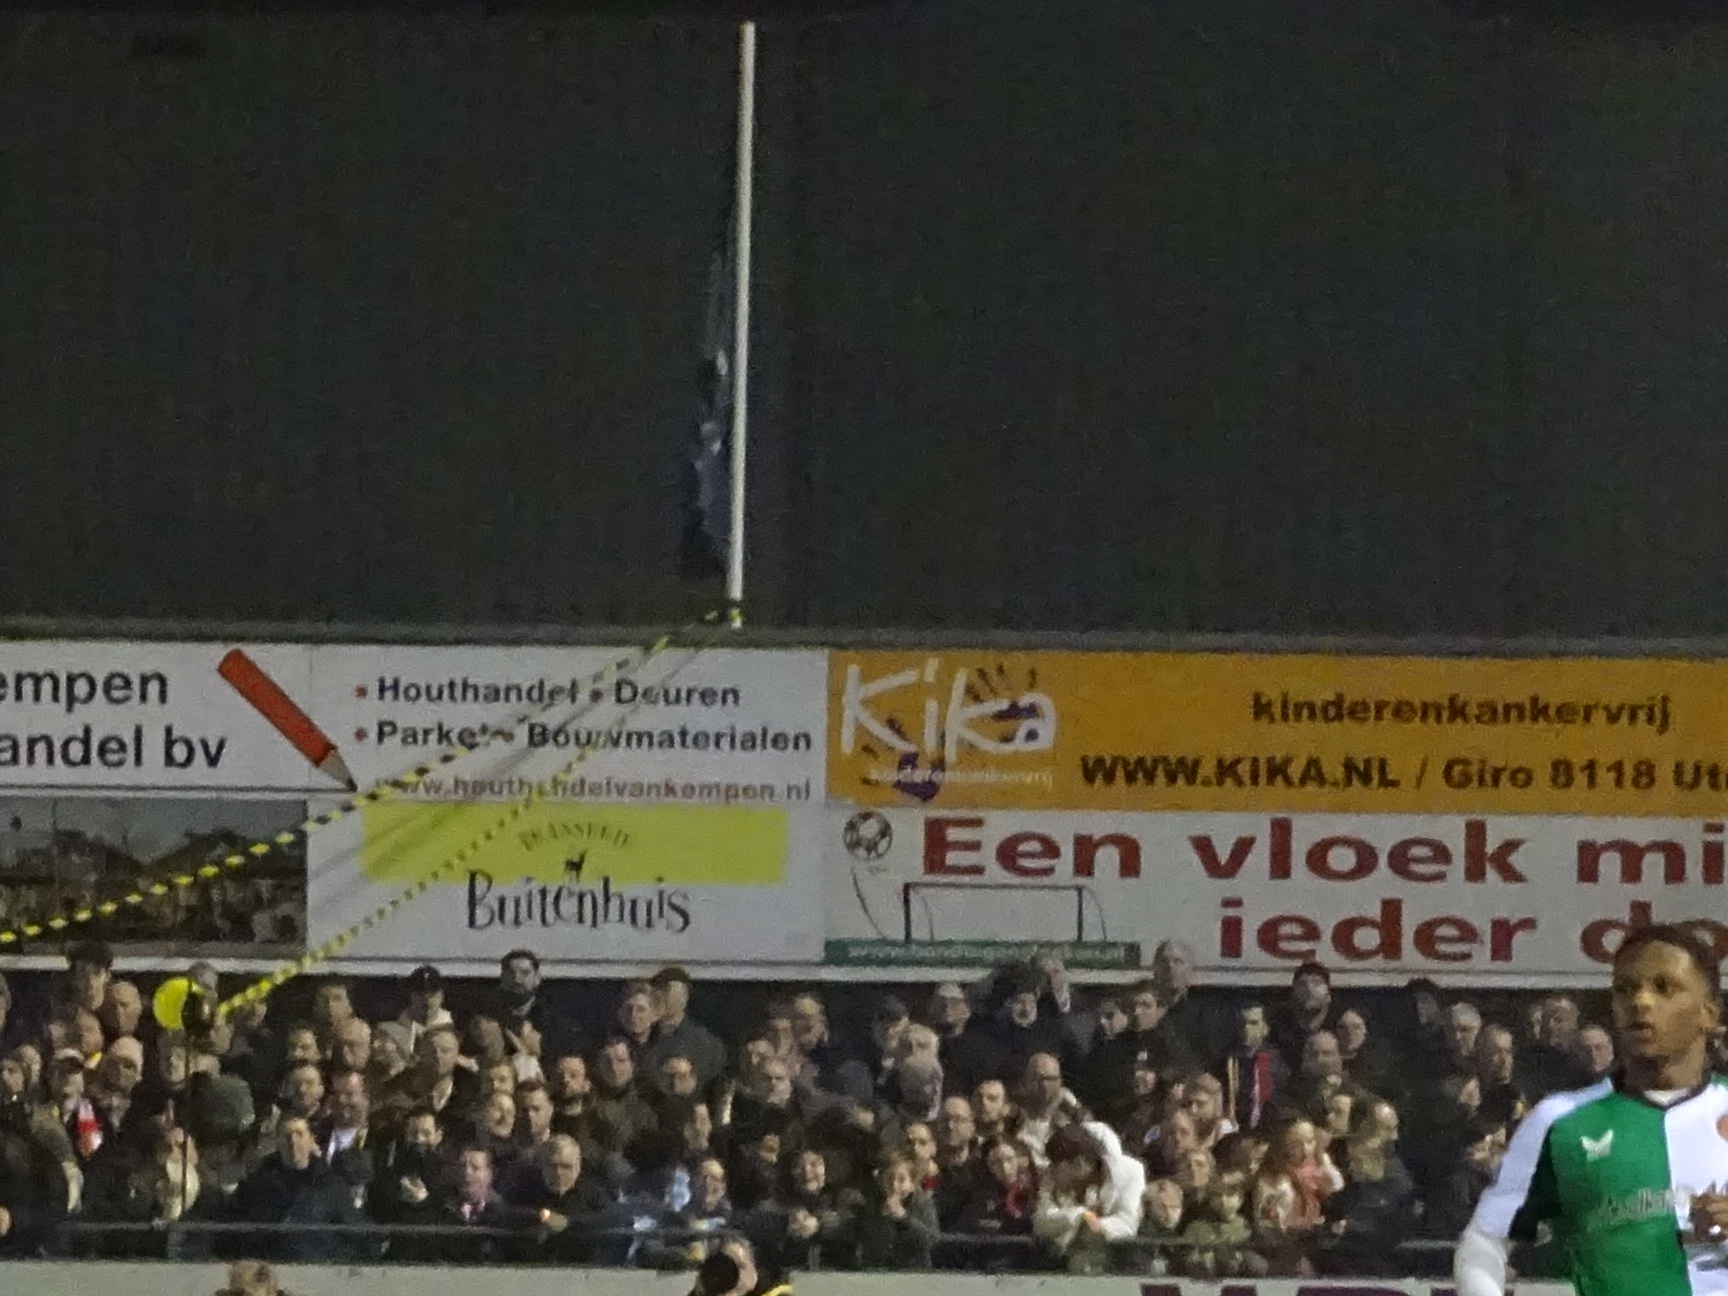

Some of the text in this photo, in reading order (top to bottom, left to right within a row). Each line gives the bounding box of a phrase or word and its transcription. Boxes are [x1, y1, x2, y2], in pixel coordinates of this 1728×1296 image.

[377, 676, 741, 707] Houthandel Deuren
[1252, 692, 1671, 735] kinderenkankervrij
[165, 725, 227, 768] bv
[1080, 754, 1400, 790] WWW.KIKA.NL
[1441, 758, 1533, 790] Giro
[1550, 758, 1657, 791] 8118
[922, 816, 1142, 879] Een
[1188, 817, 1528, 884] vloek
[467, 868, 690, 933] Buitenhuis
[1220, 897, 1537, 962] ieder
